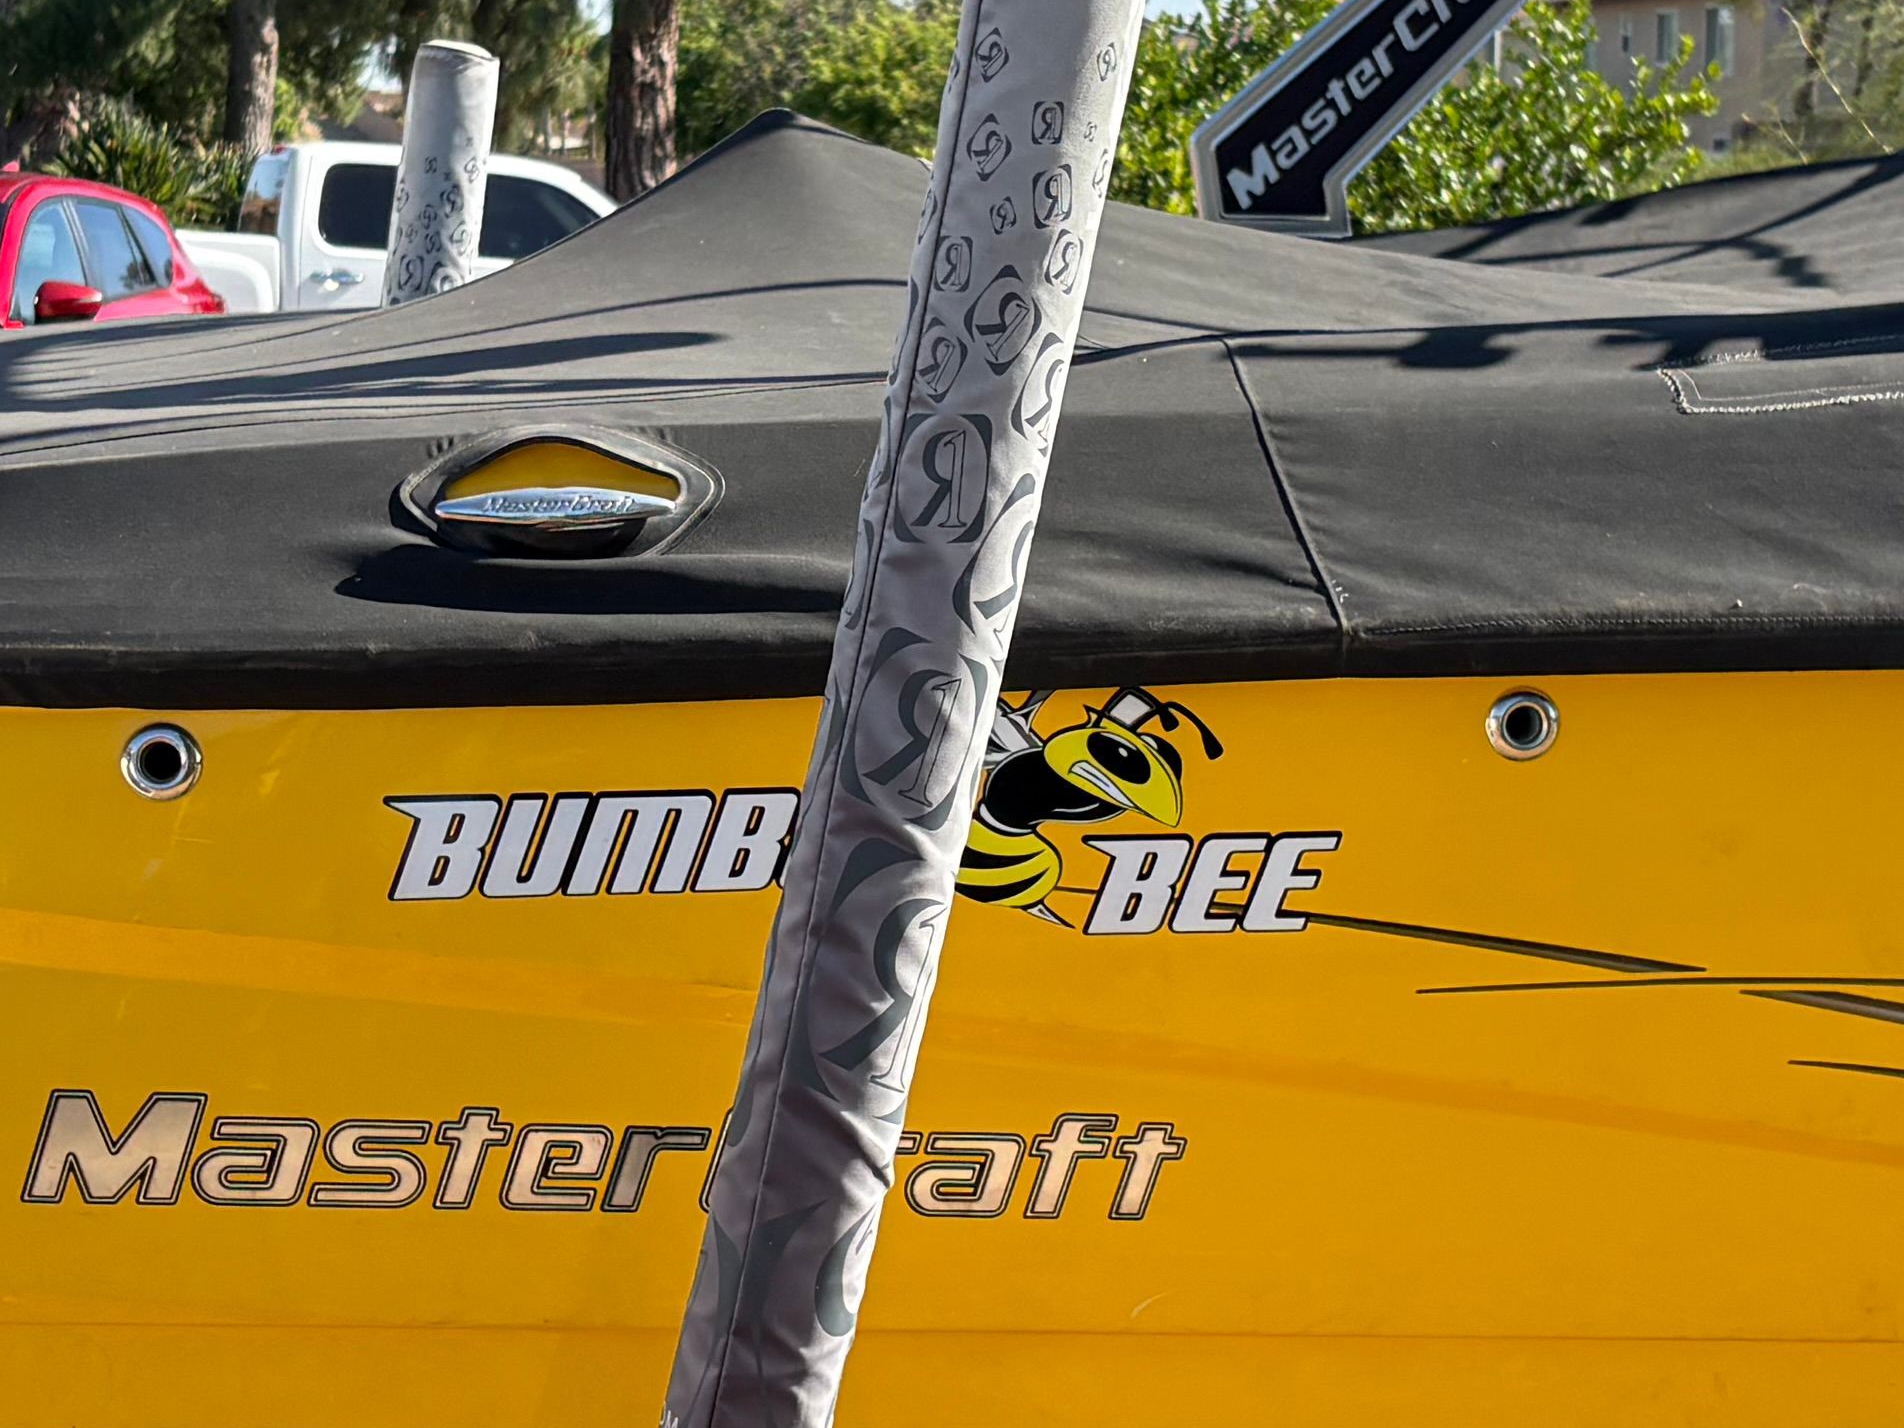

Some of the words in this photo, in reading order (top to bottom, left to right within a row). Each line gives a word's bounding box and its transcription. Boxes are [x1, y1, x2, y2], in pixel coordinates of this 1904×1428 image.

[382, 786, 800, 903] BUMB
[1079, 829, 1343, 937] BEE
[21, 1087, 1186, 1221] Masteraft
